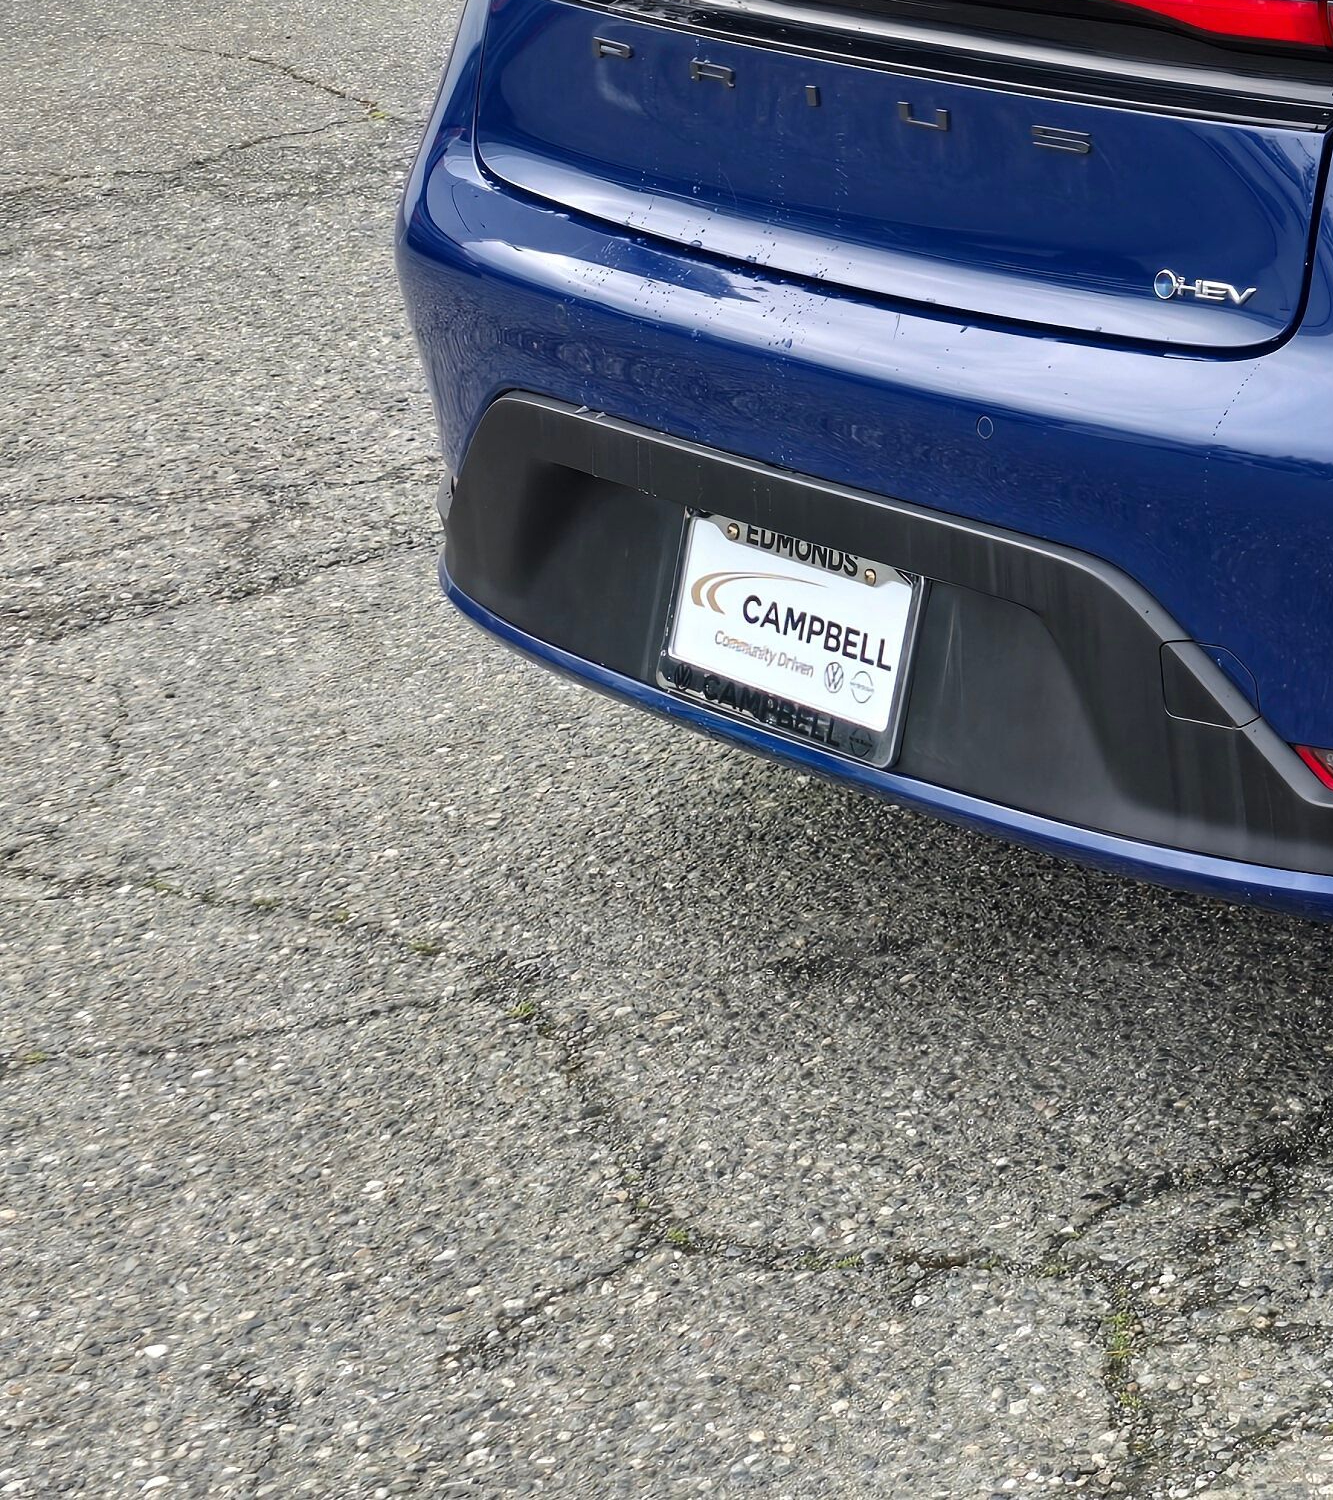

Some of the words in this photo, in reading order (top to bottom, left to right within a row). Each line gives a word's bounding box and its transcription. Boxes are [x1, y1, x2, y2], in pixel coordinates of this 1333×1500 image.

[593, 36, 1091, 154] PRIUS
[1177, 276, 1257, 305] HEV
[745, 524, 859, 578] EDMONDS
[714, 629, 778, 668] Community
[777, 651, 815, 678] Driven
[742, 595, 892, 672] CAMPBELL
[702, 674, 841, 748] CAMPBELL
